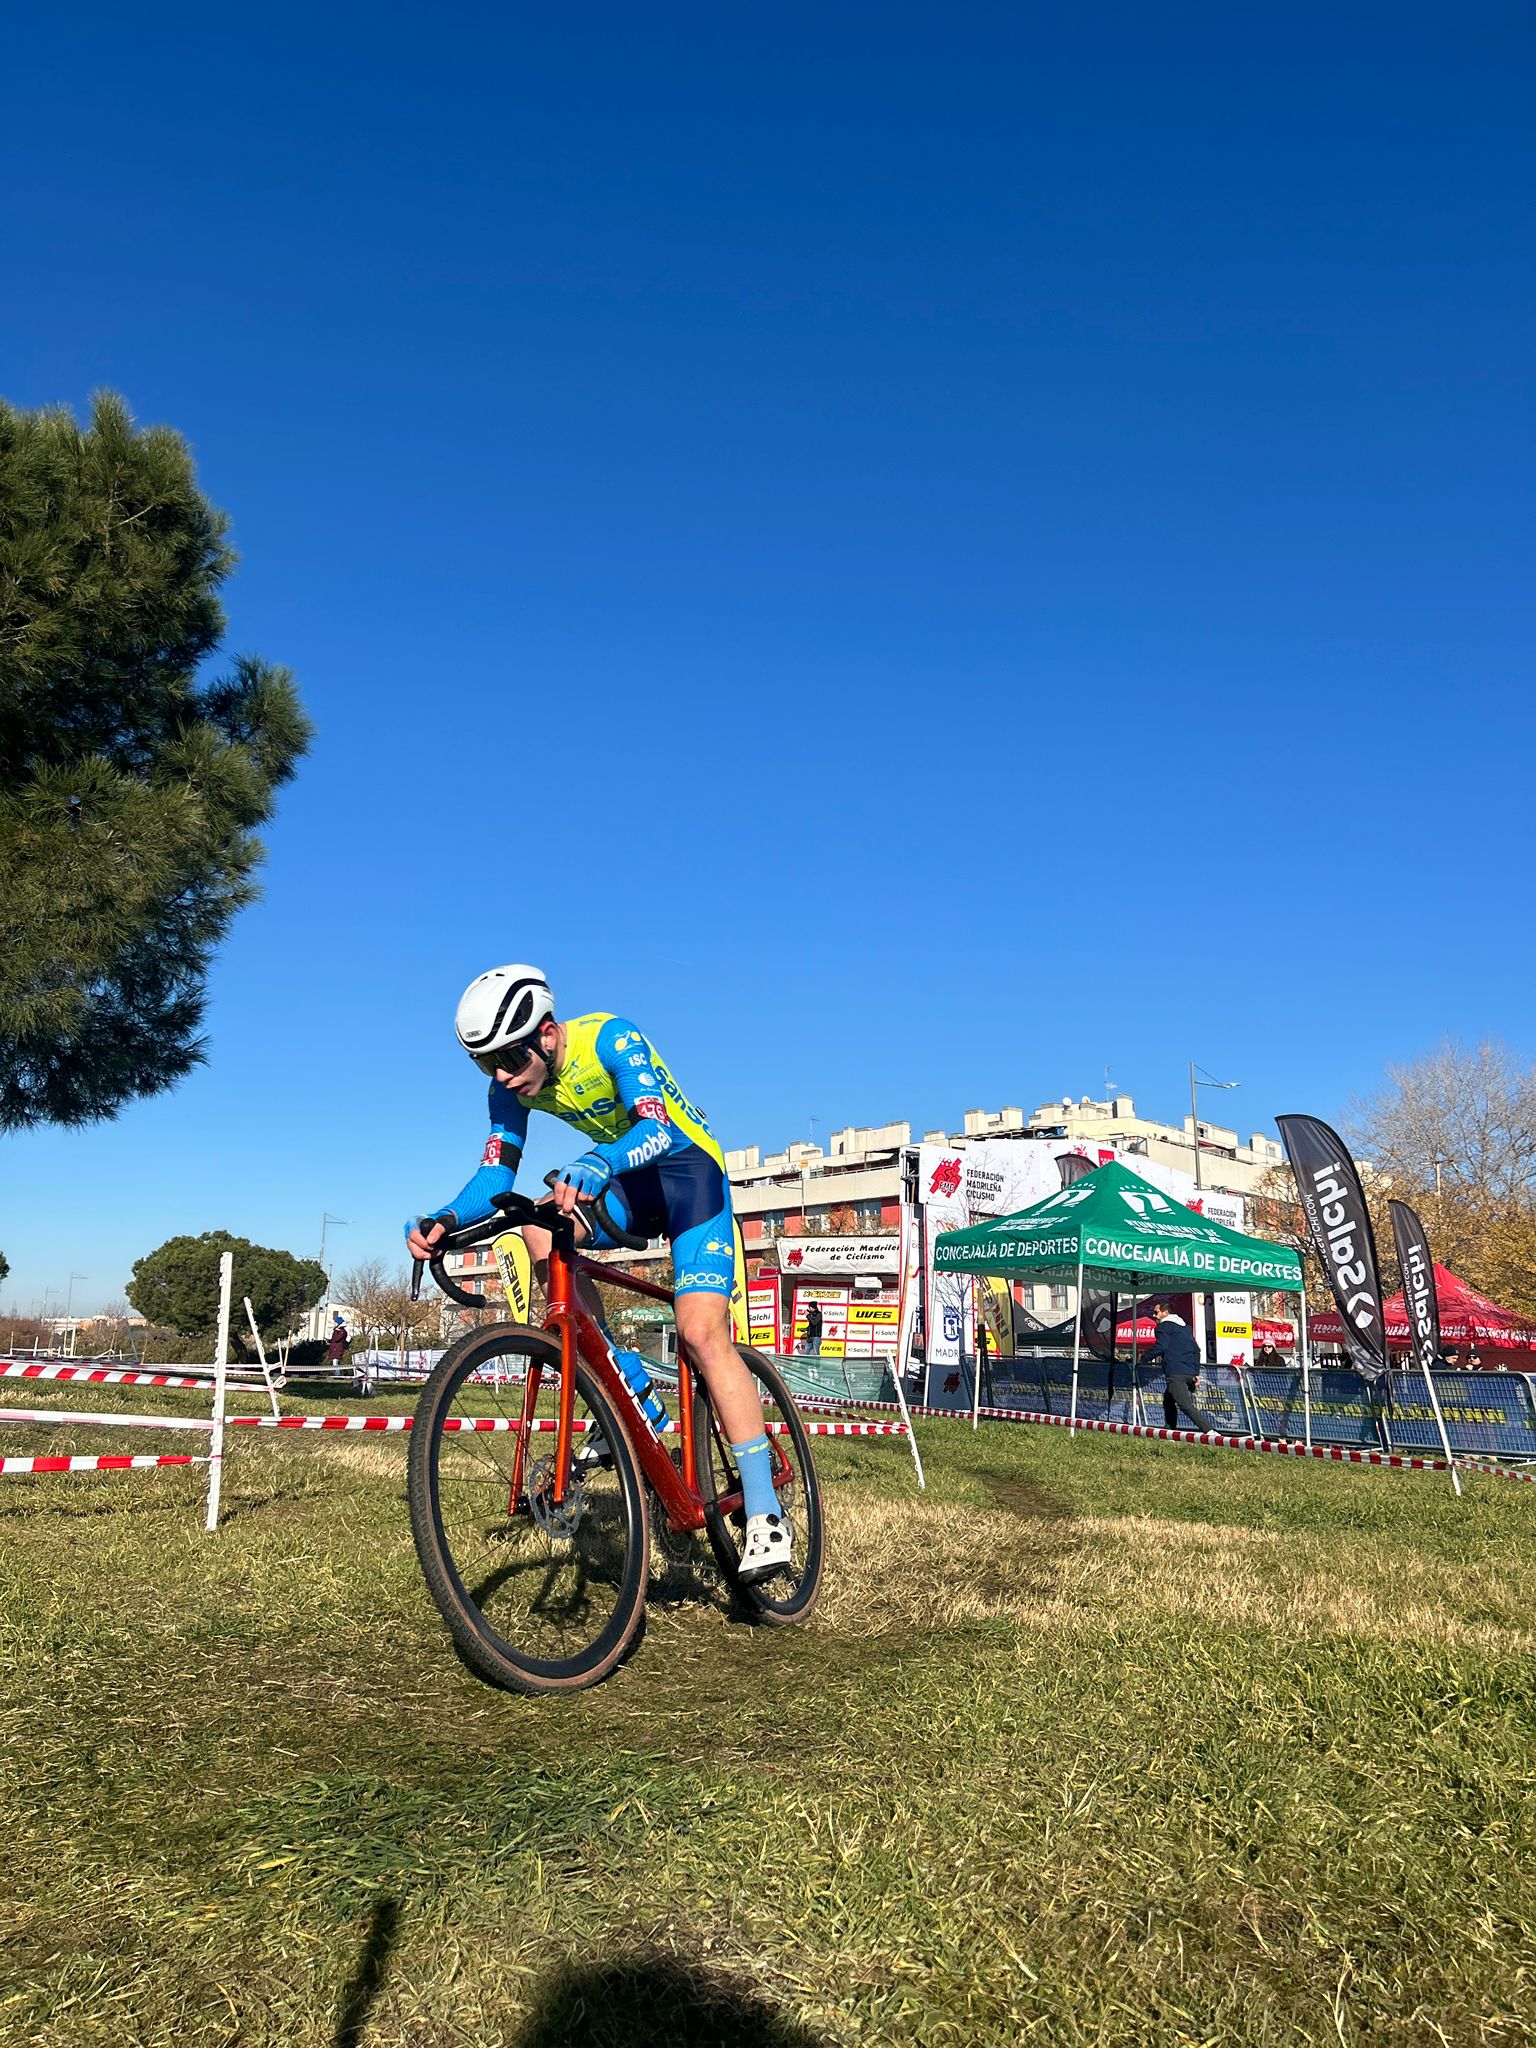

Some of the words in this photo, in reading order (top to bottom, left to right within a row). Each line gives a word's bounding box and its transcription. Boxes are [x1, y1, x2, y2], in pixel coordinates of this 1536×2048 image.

[627, 1124, 672, 1168] mobel
[966, 1168, 1005, 1182] FEDERACIÓN
[966, 1179, 1002, 1192] MADRILEÑA
[966, 1189, 995, 1202] CICLISMO
[805, 1244, 855, 1253] Federación
[935, 1240, 997, 1261] CONCEJALÍA
[1000, 1241, 1016, 1258] DE
[1016, 1236, 1078, 1257] DEPORTES
[846, 1253, 885, 1261] Ciclismo
[1085, 1237, 1190, 1267] CONCEJALÍA
[1193, 1252, 1215, 1271] DE
[1219, 1256, 1302, 1281] DEPORTES
[1226, 1296, 1246, 1304] Salchi
[855, 1310, 893, 1319] UVES
[1222, 1325, 1247, 1334] UVES
